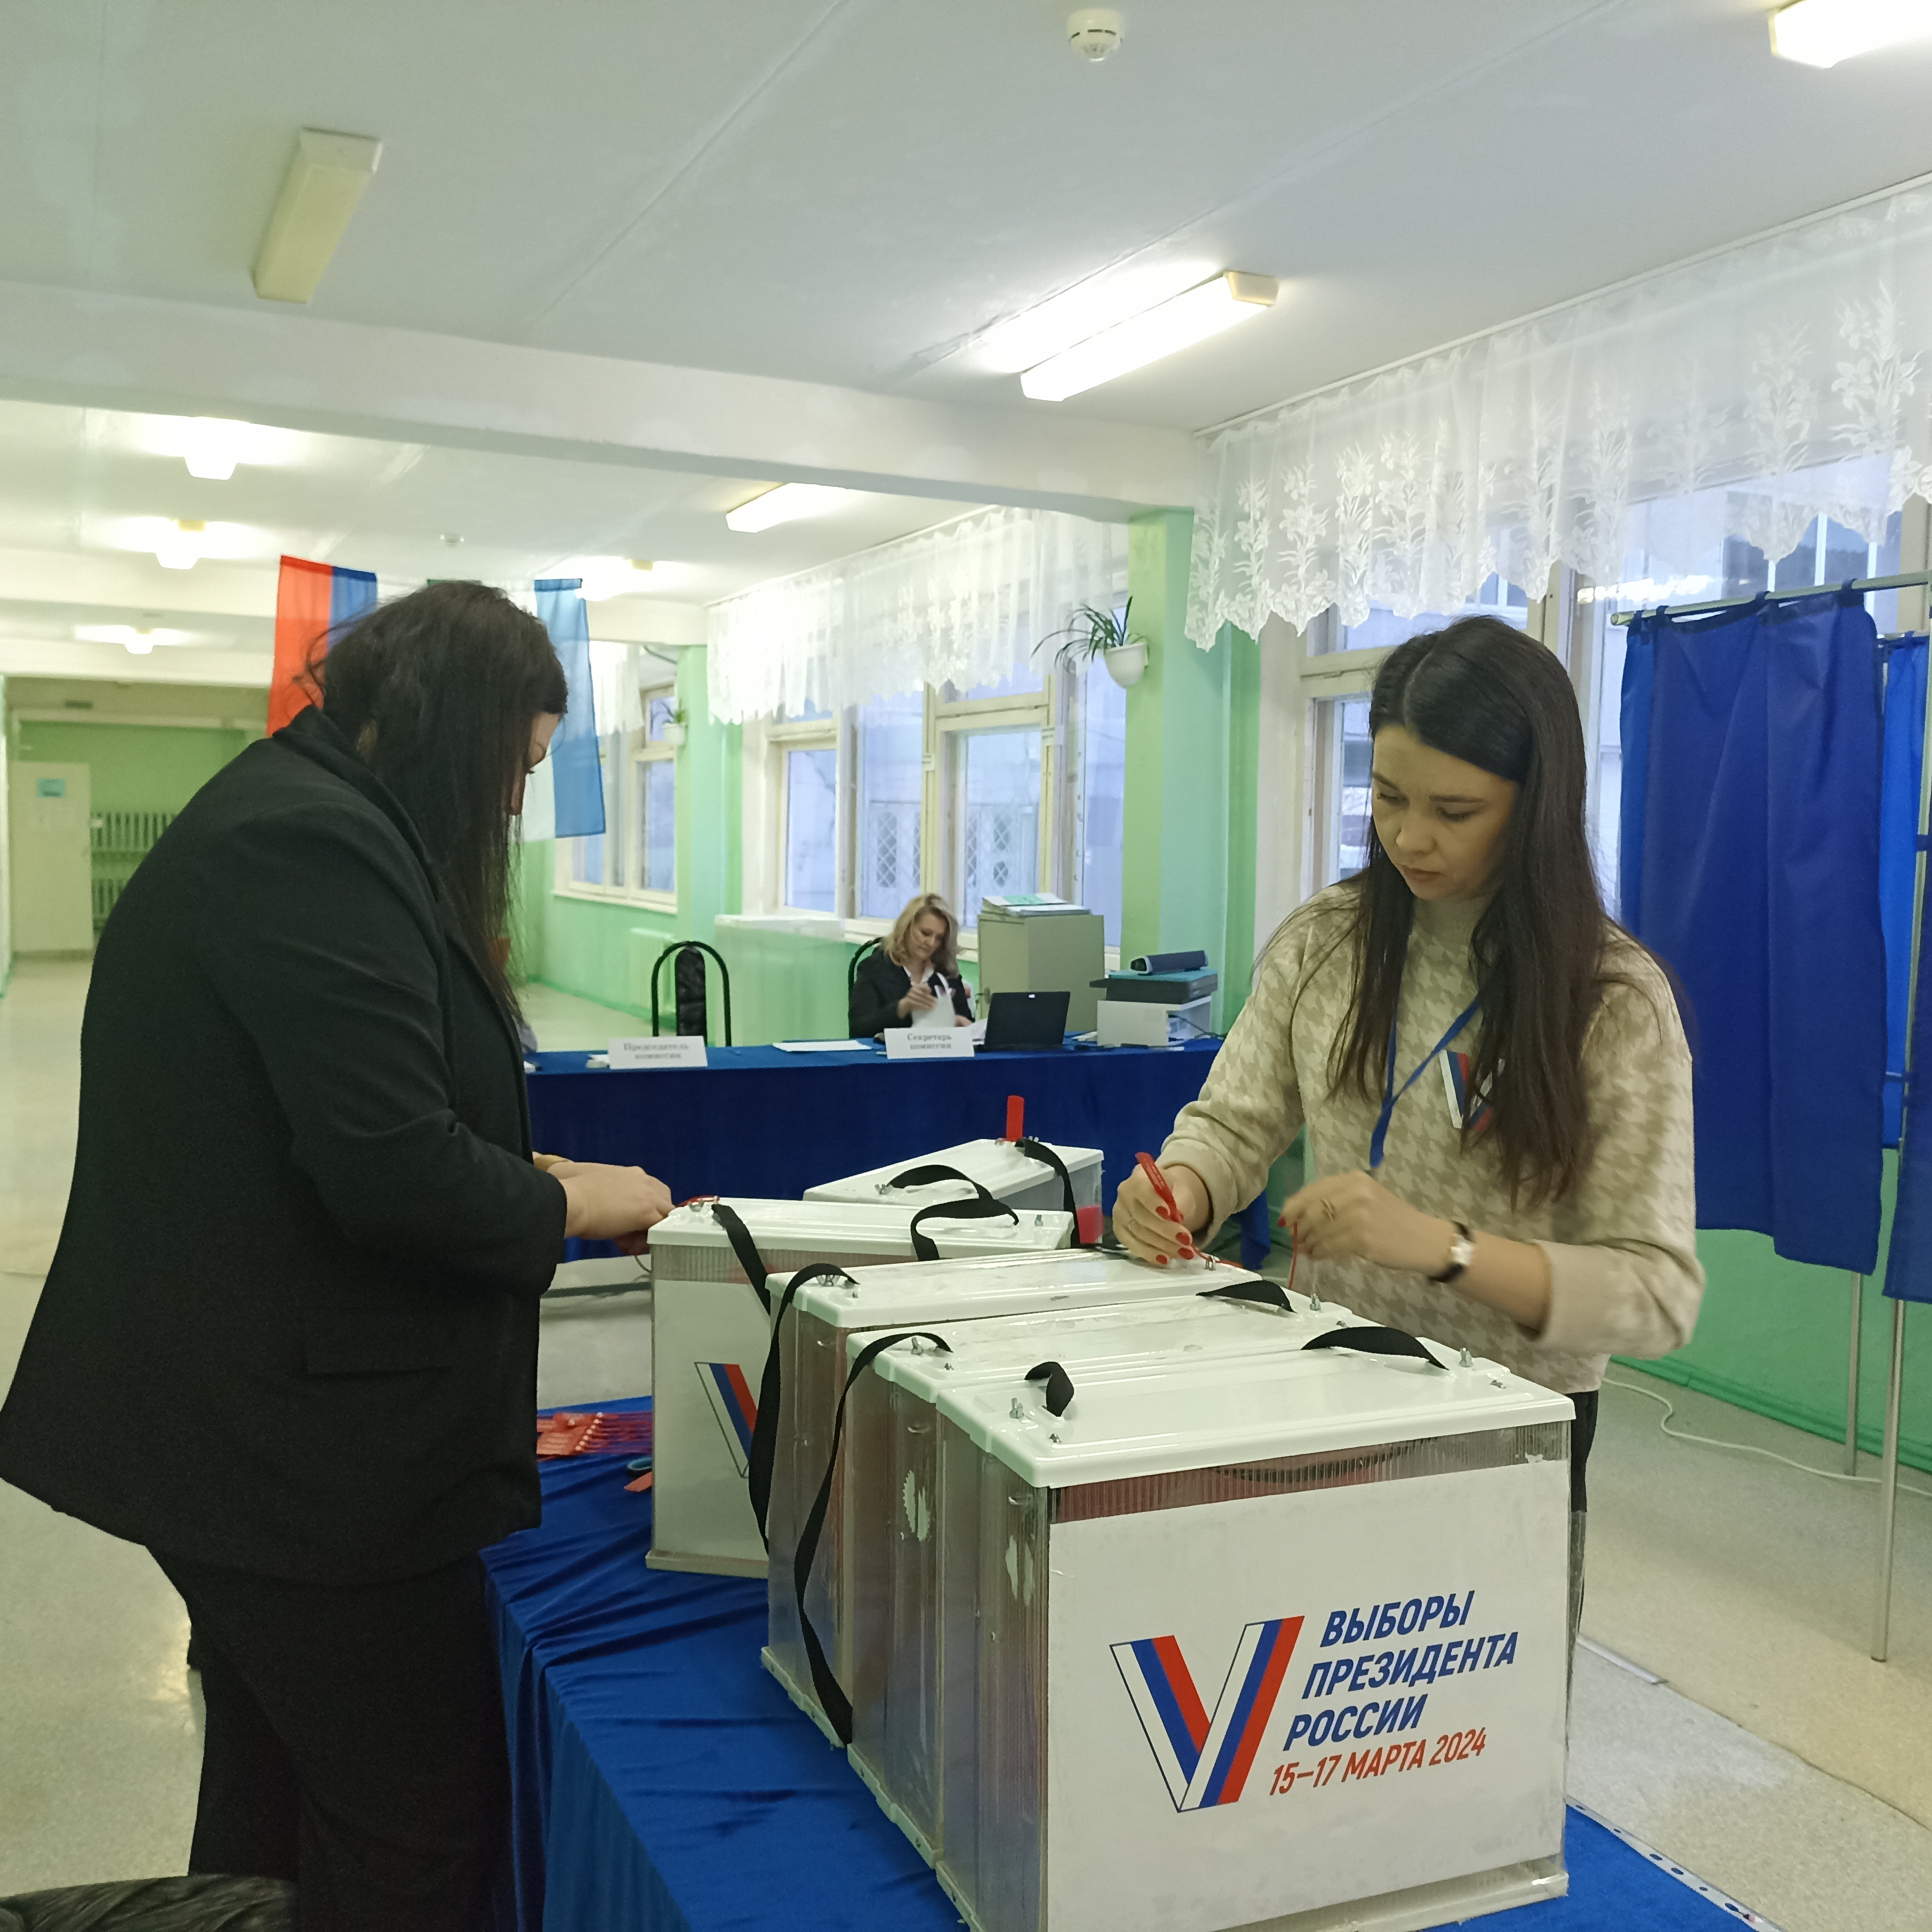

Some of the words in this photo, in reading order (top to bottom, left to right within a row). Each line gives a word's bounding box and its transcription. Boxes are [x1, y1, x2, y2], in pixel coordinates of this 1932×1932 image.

[1320, 1590, 1475, 1647] ВЫБОРЫ
[1302, 1632, 1519, 1700] ПРЕЗИДЕНТА
[1283, 1694, 1428, 1751] РОССИИ
[1342, 1740, 1427, 1782] МАРТА
[1428, 1727, 1487, 1766] 2024
